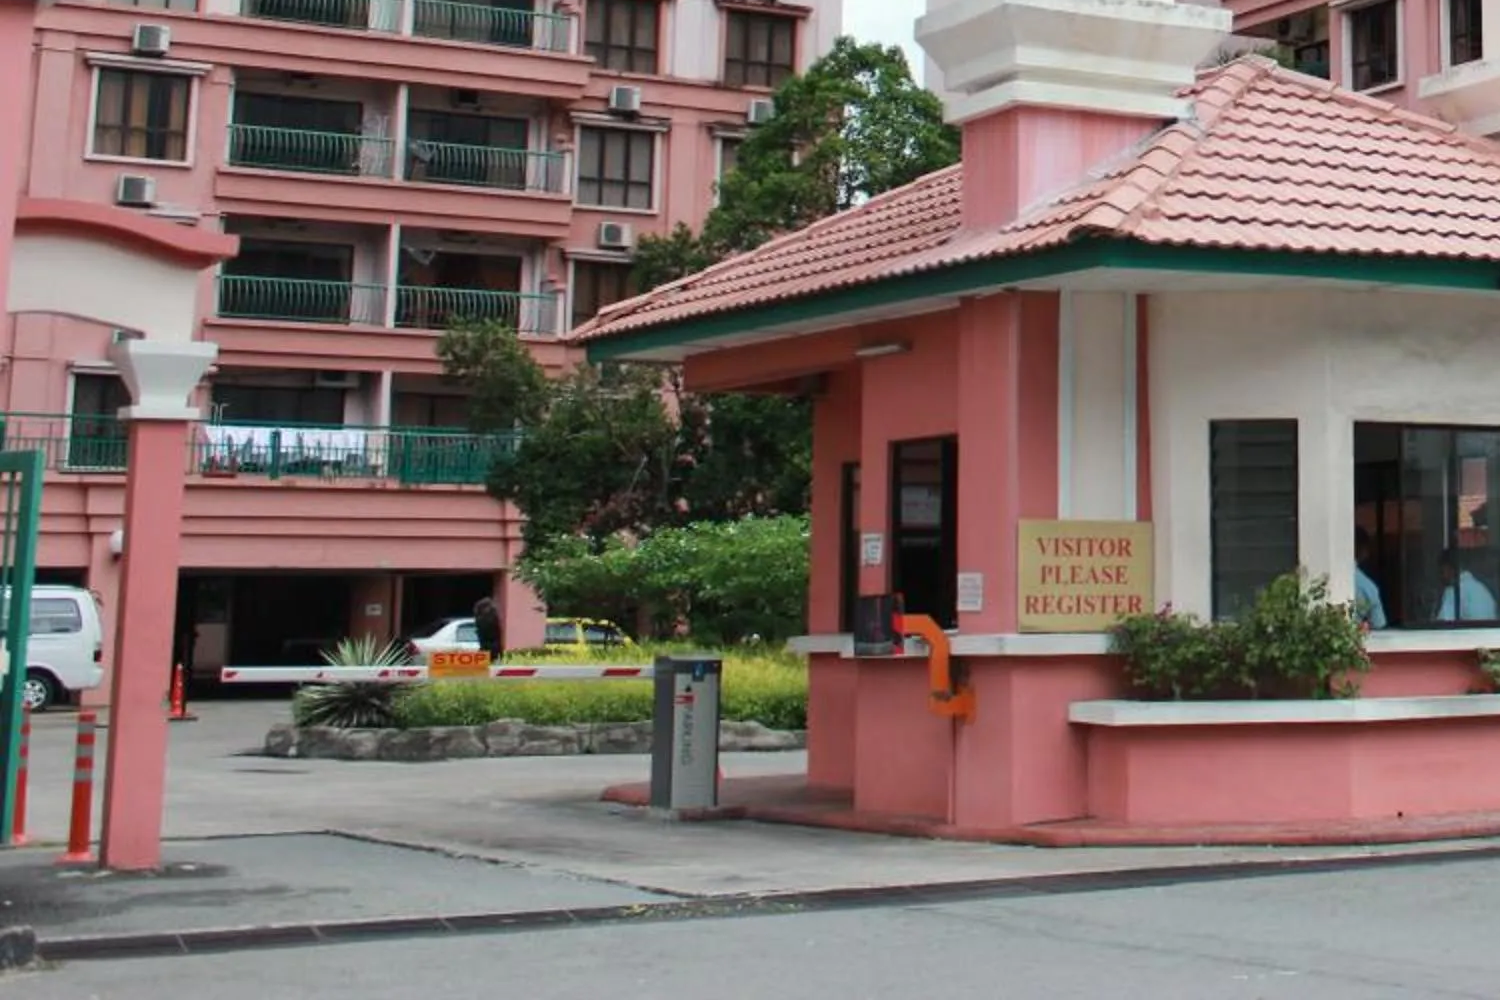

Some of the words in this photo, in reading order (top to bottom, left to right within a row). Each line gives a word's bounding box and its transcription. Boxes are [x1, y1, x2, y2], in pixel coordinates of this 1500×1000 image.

[1036, 537, 1132, 557] VISITOR
[1041, 565, 1128, 584] PLEASE
[1025, 594, 1142, 614] REGISTER
[433, 652, 487, 665] STOP
